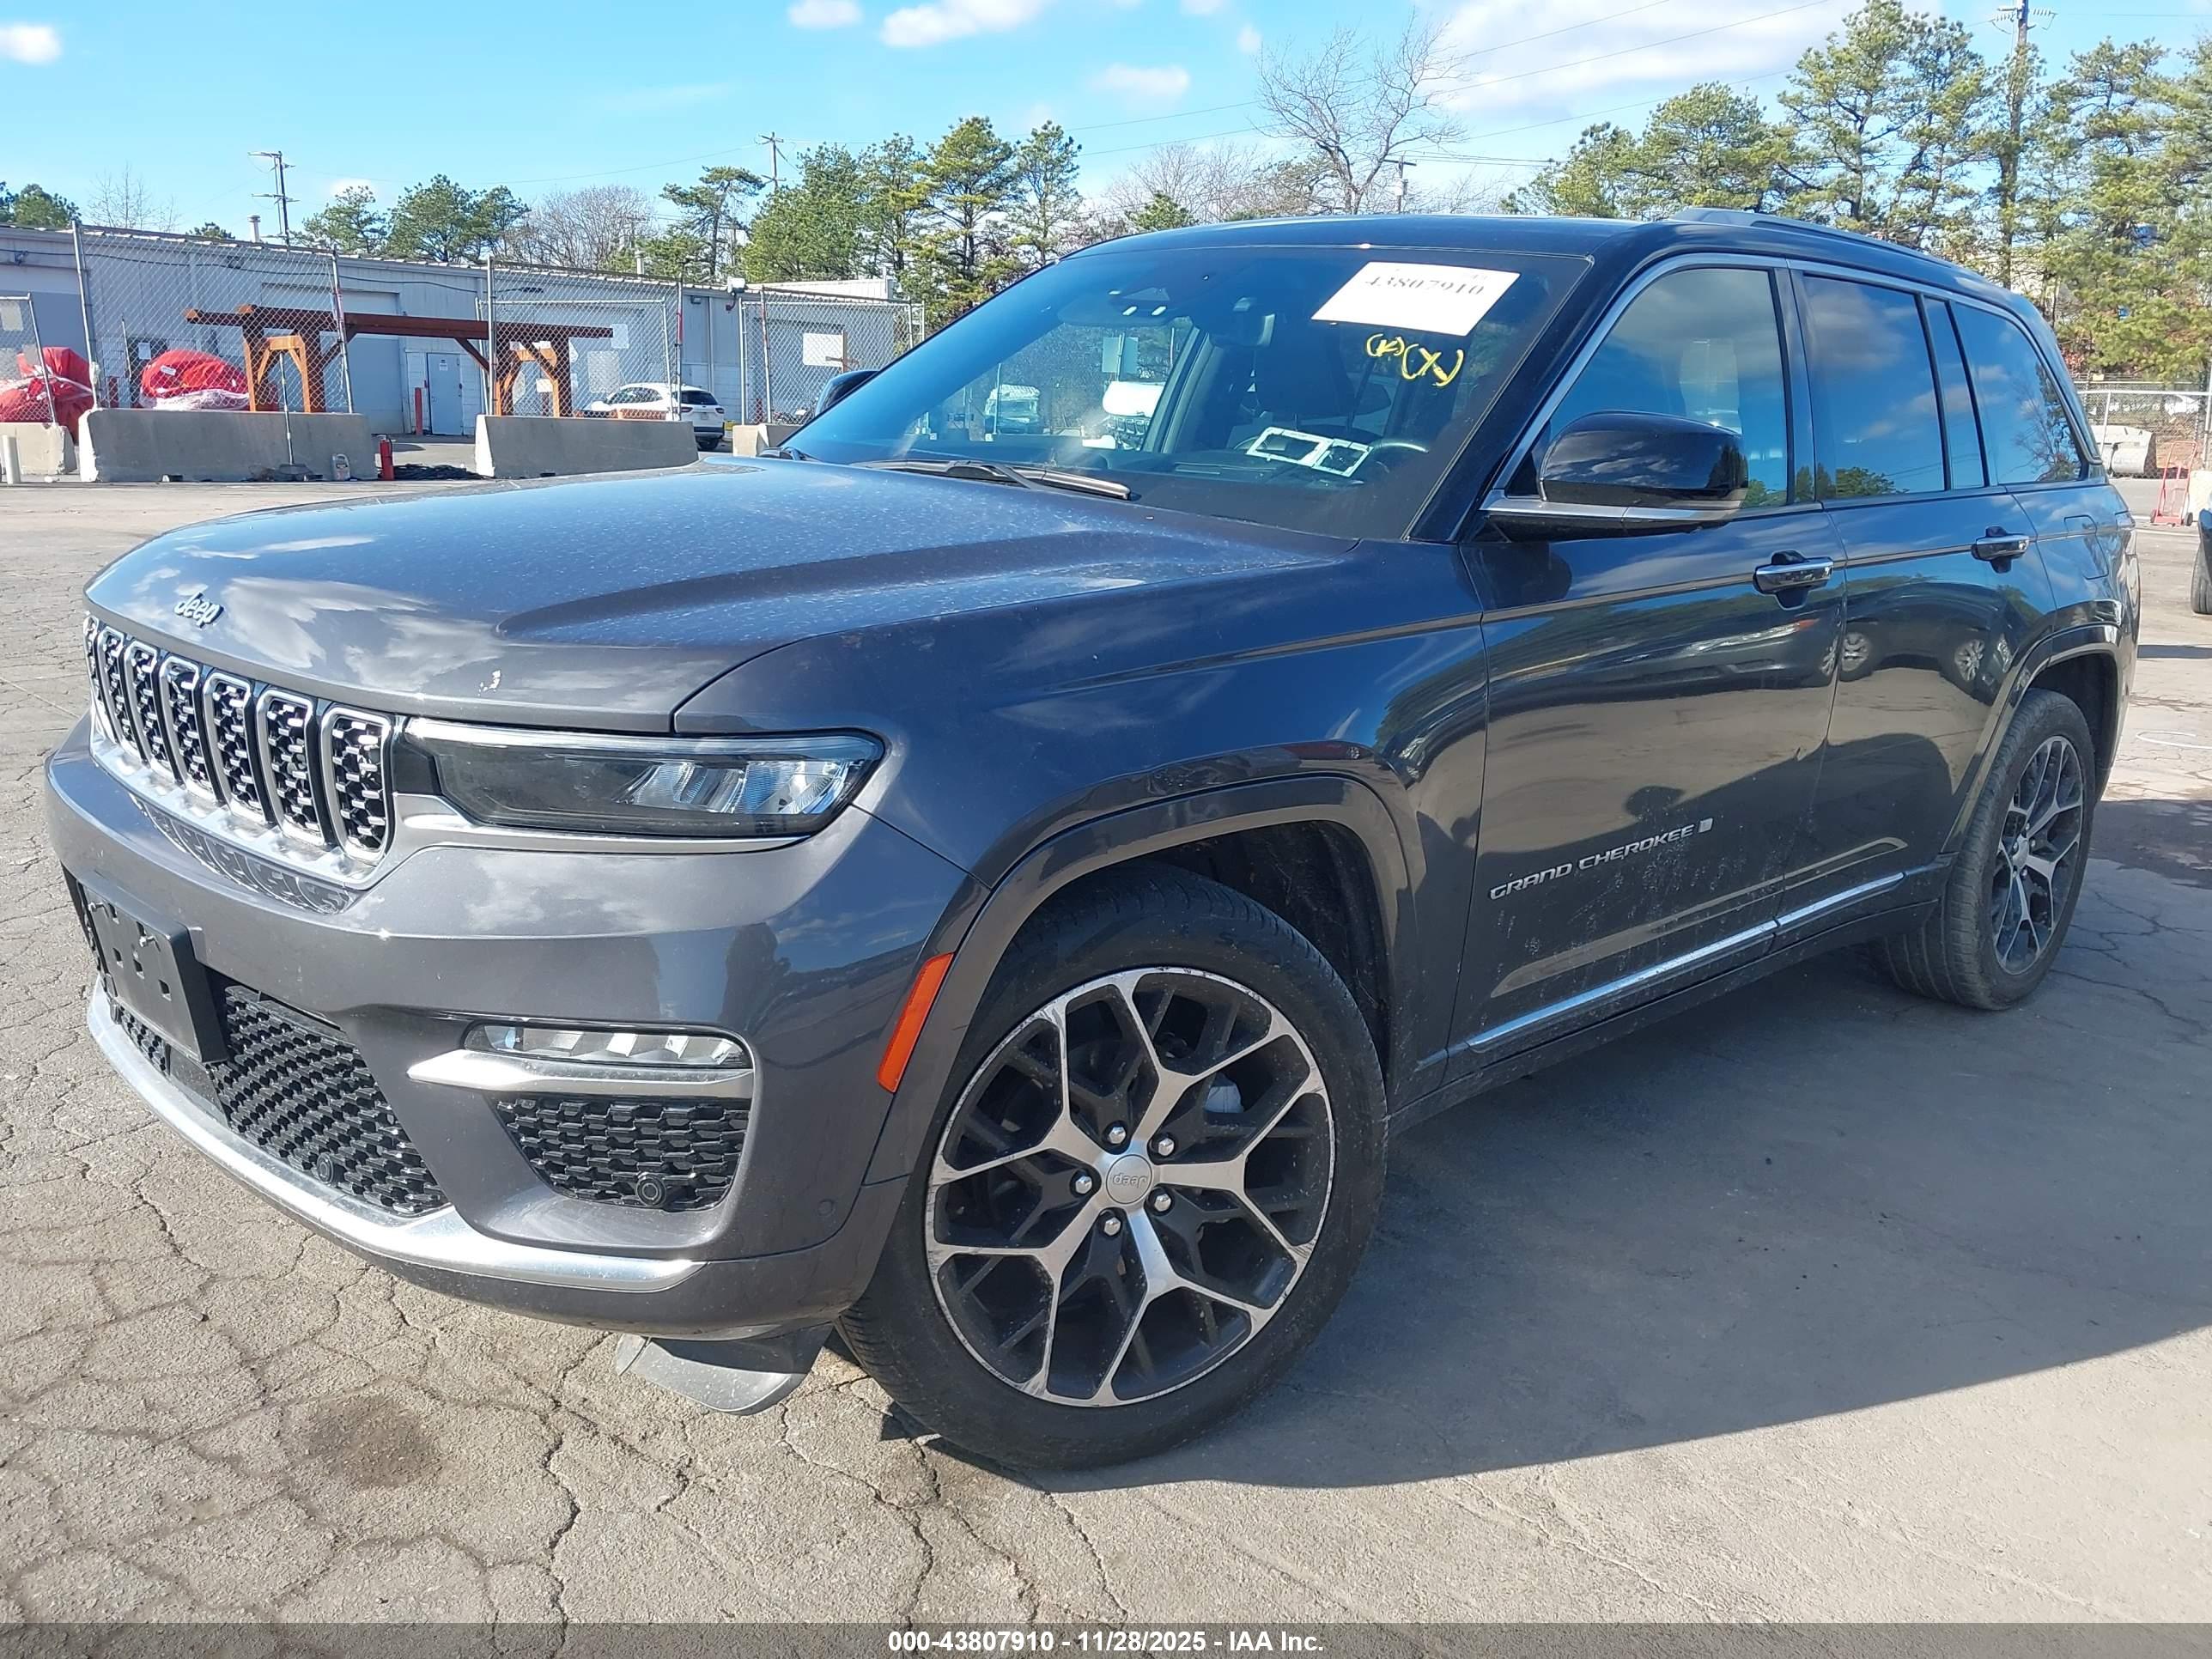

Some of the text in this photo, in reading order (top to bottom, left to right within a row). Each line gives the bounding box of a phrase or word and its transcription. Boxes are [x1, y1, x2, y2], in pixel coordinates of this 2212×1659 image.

[1365, 276, 1485, 295] 43807910
[173, 592, 224, 629] Jeep
[1489, 823, 1696, 900] GRAND CHEROKEE
